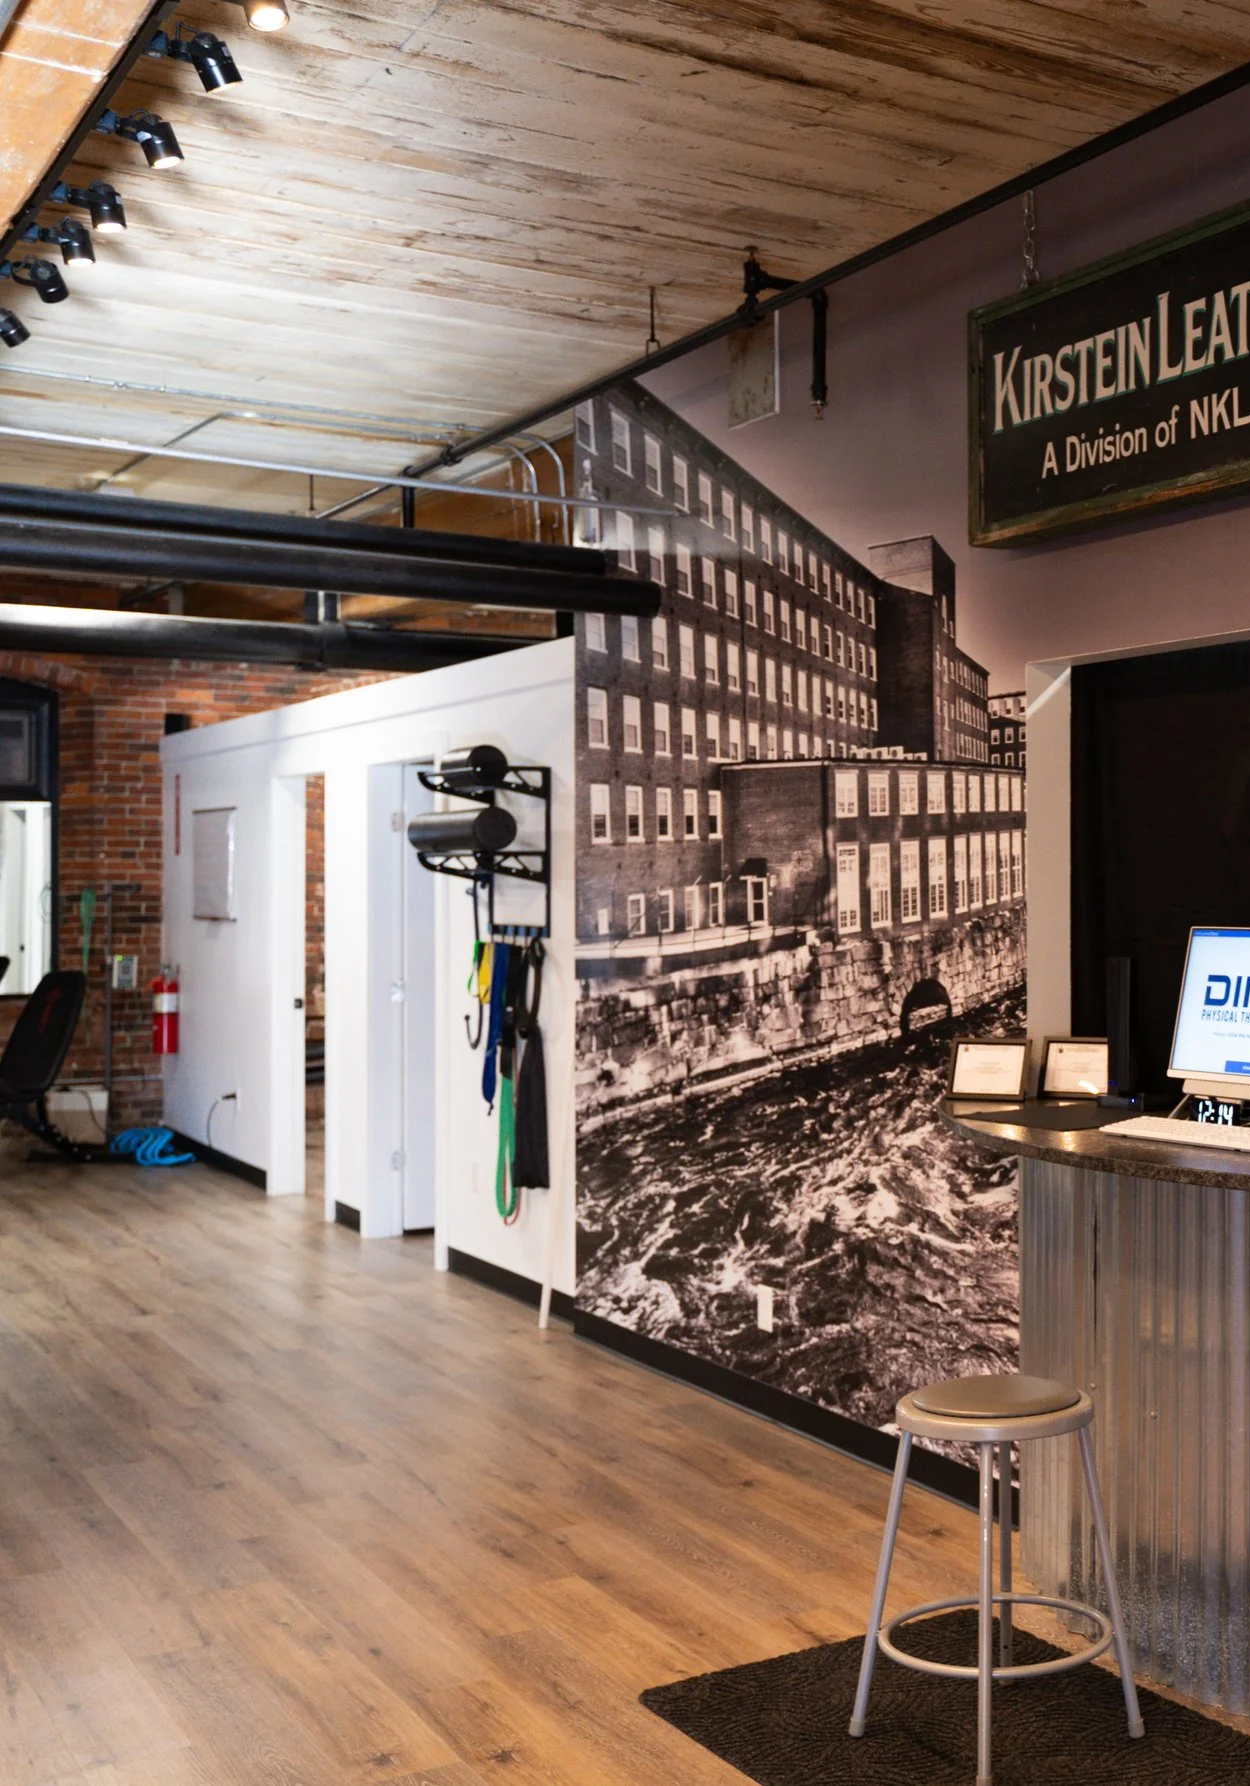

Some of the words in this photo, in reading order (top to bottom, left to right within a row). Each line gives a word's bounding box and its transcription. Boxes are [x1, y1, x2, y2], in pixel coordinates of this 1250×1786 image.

[993, 316, 1151, 434] KIRSTEIN
[1041, 442, 1059, 479] A
[1066, 423, 1147, 473] Division
[1155, 404, 1179, 448] of
[1201, 1009, 1238, 1023] PHYSICAL
